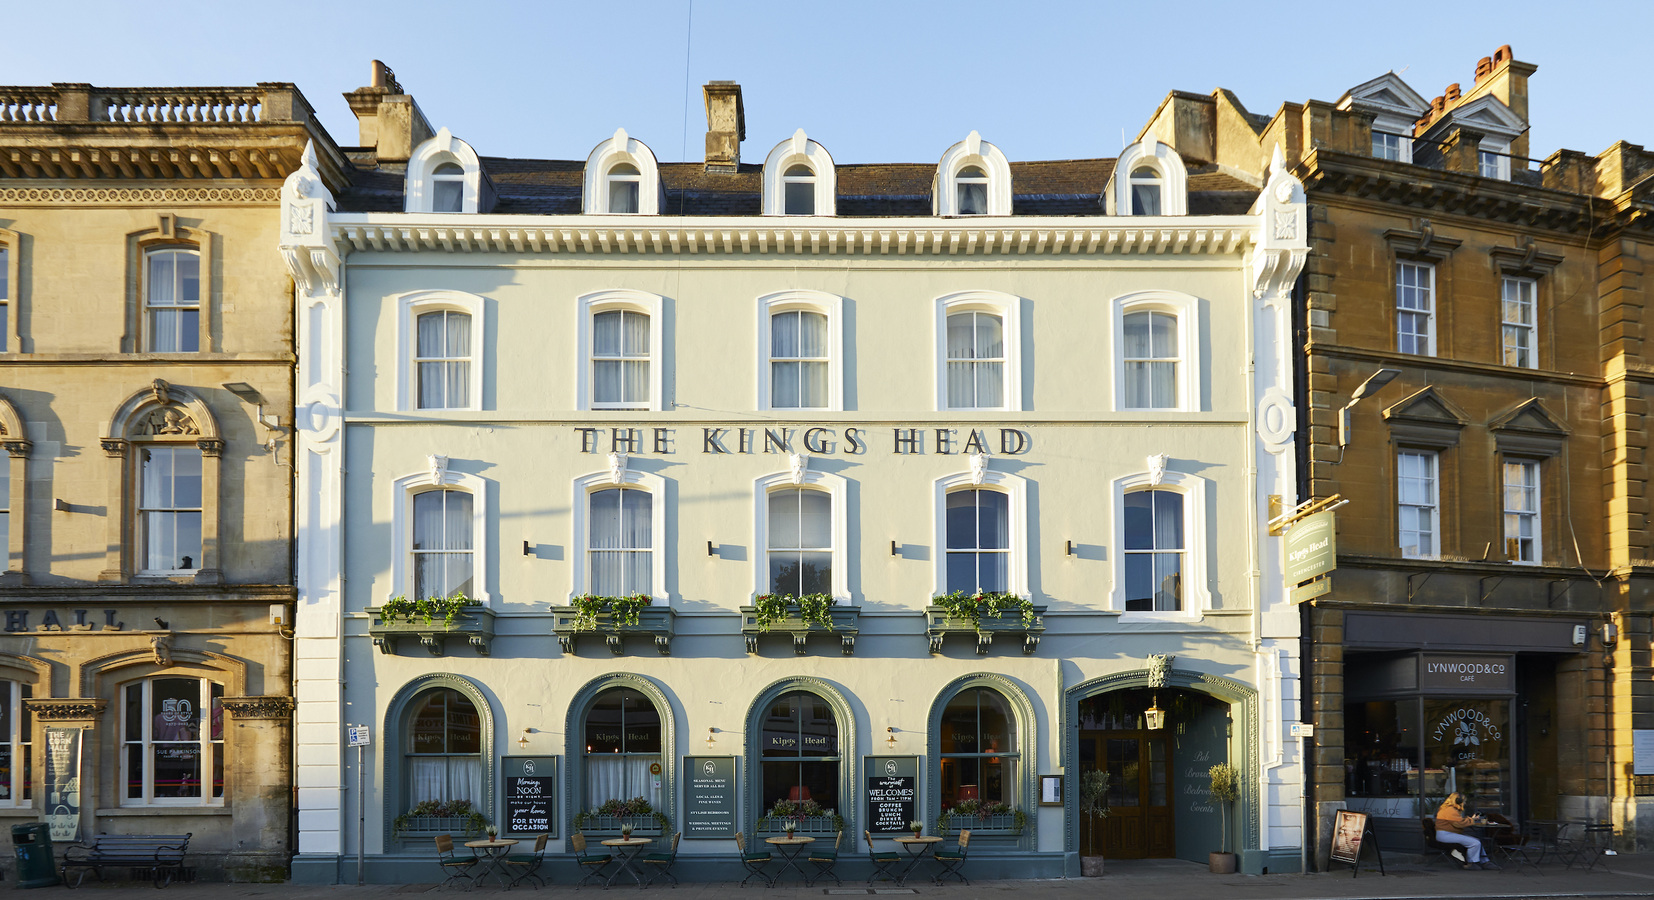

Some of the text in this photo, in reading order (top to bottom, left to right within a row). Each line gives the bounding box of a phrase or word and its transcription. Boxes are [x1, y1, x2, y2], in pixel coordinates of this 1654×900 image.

[574, 427, 1026, 455] THE KINGS HEAD
[1288, 536, 1329, 562] Kings Head
[1293, 560, 1325, 577] CIRENCESTER
[4, 609, 124, 632] HALL
[162, 699, 192, 722] 50
[772, 737, 796, 747] Kings
[804, 736, 826, 744] Head
[516, 786, 542, 795] NOON
[869, 789, 914, 797] WELCOMES
